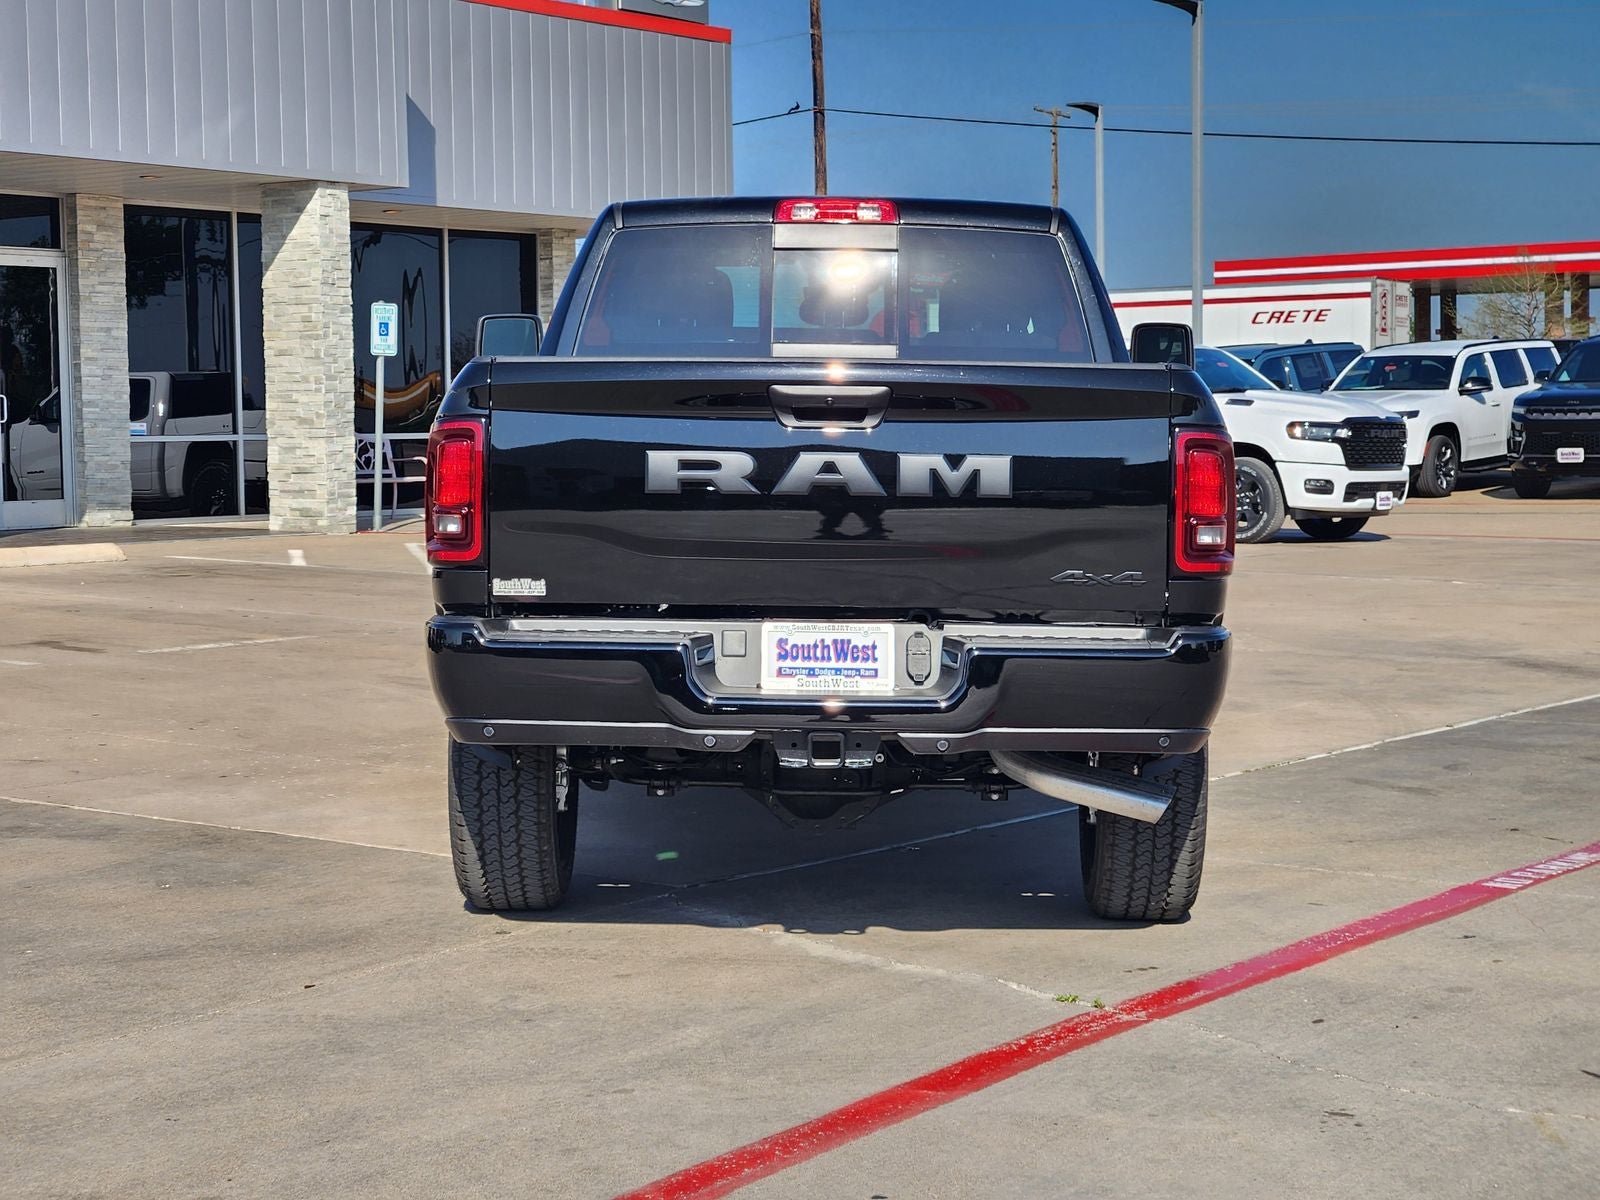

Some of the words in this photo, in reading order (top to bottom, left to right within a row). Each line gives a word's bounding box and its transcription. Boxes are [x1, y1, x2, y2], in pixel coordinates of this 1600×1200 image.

[1251, 309, 1332, 324] CRETE
[645, 450, 1012, 498] RAM
[1050, 569, 1147, 586] 4x4
[776, 637, 878, 663] SouthWest
[781, 667, 809, 676] Chrysler
[815, 668, 836, 676] Dodge
[841, 668, 856, 677] Jeep
[860, 668, 876, 676] Ram
[797, 678, 860, 689] SouthWest
